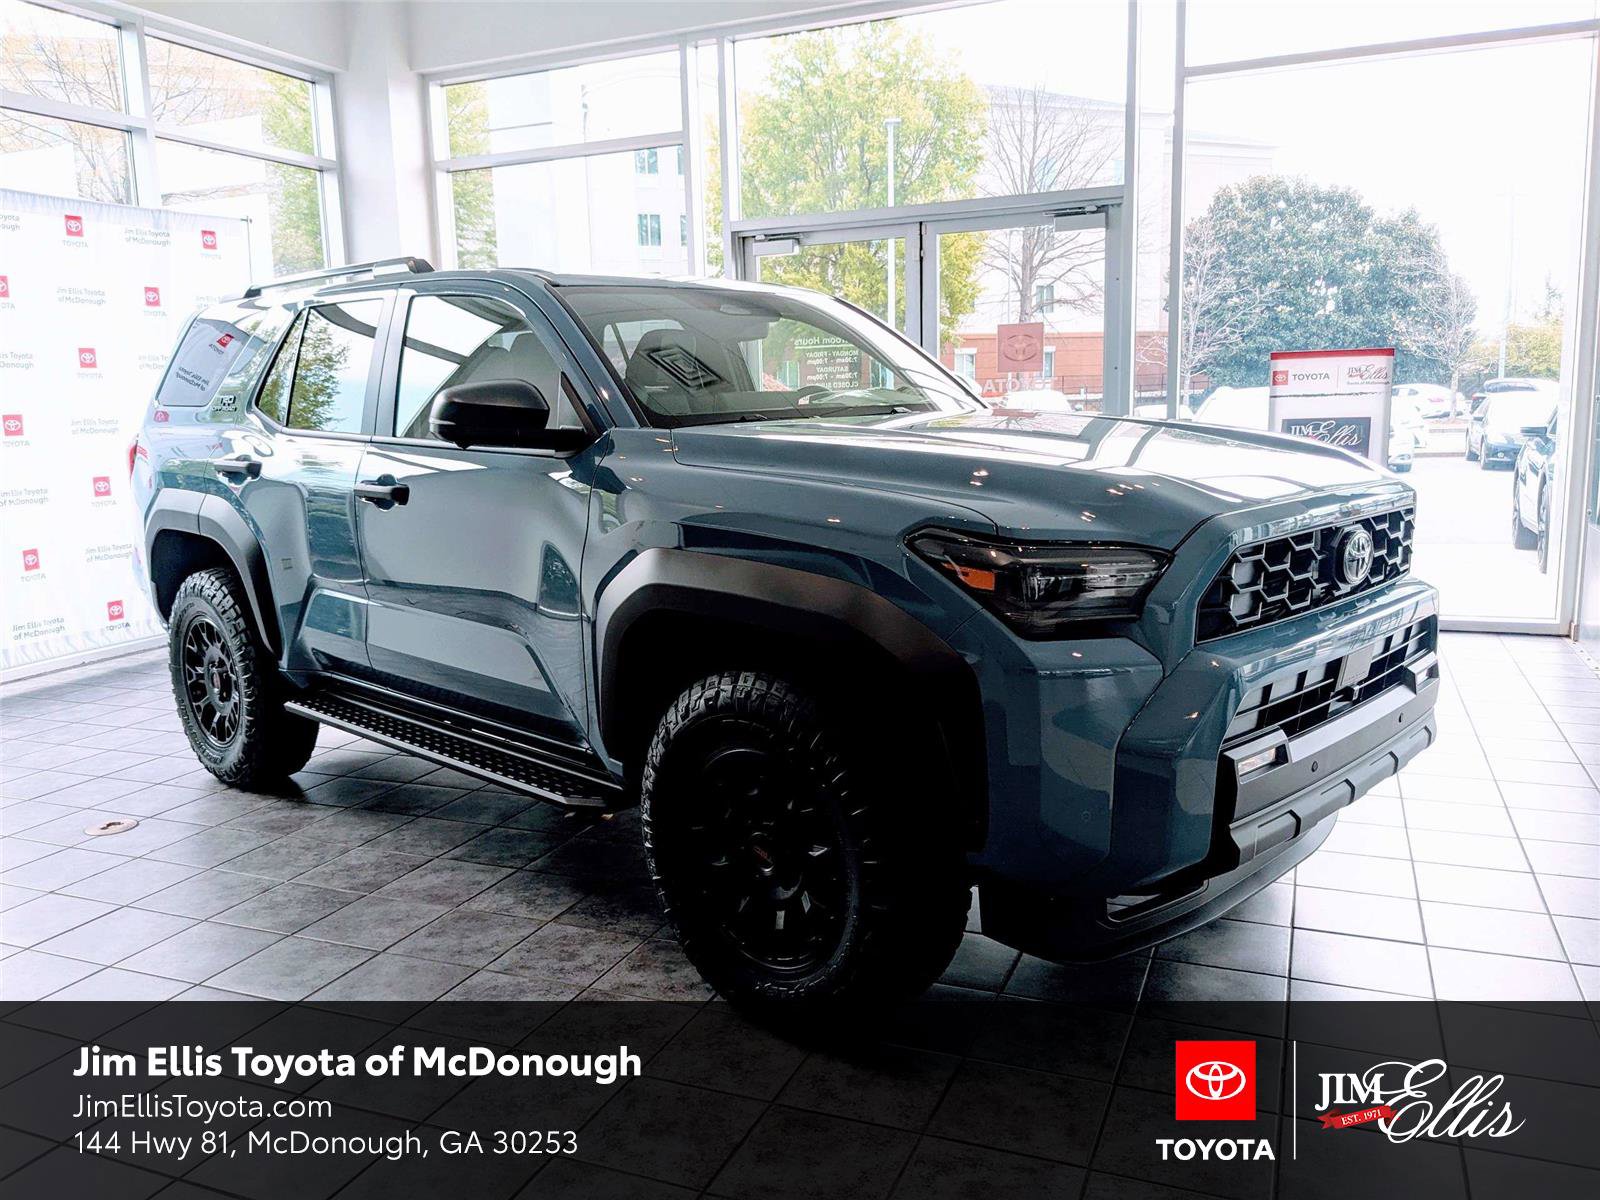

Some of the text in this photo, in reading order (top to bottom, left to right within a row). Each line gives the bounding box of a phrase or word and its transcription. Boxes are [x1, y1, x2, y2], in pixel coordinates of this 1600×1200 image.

[148, 230, 170, 238] Toyota
[62, 240, 88, 248] TOYOTA
[10, 352, 33, 360] Toyota
[1292, 373, 1330, 381] TOYOTA
[1290, 420, 1362, 447] JIM Ellis
[13, 617, 65, 632] Jim Ellis Toyota
[106, 622, 130, 631] TOYOTA
[13, 625, 65, 640] of McDonough
